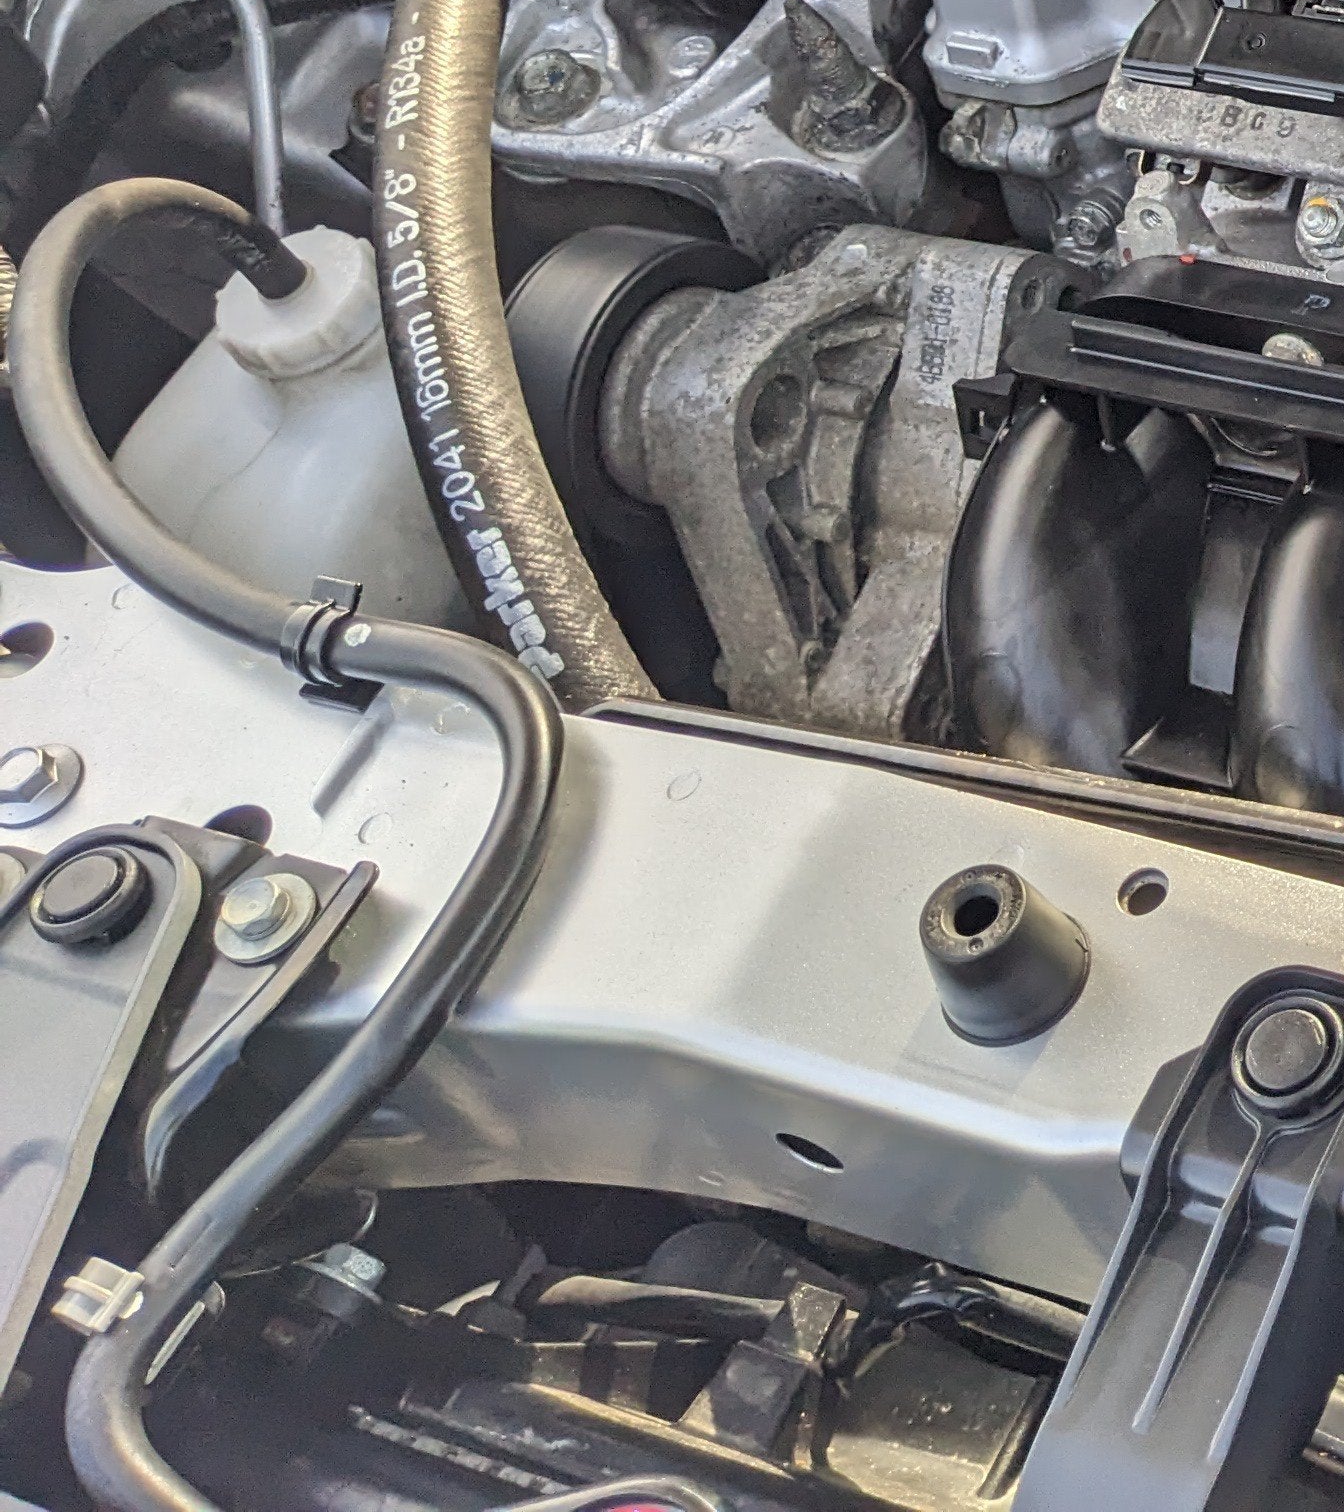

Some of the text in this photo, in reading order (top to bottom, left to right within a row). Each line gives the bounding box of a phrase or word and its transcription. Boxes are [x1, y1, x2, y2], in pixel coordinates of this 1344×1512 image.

[384, 35, 426, 130] R134a
[407, 311, 452, 422] 16mm
[428, 428, 486, 522] 2041
